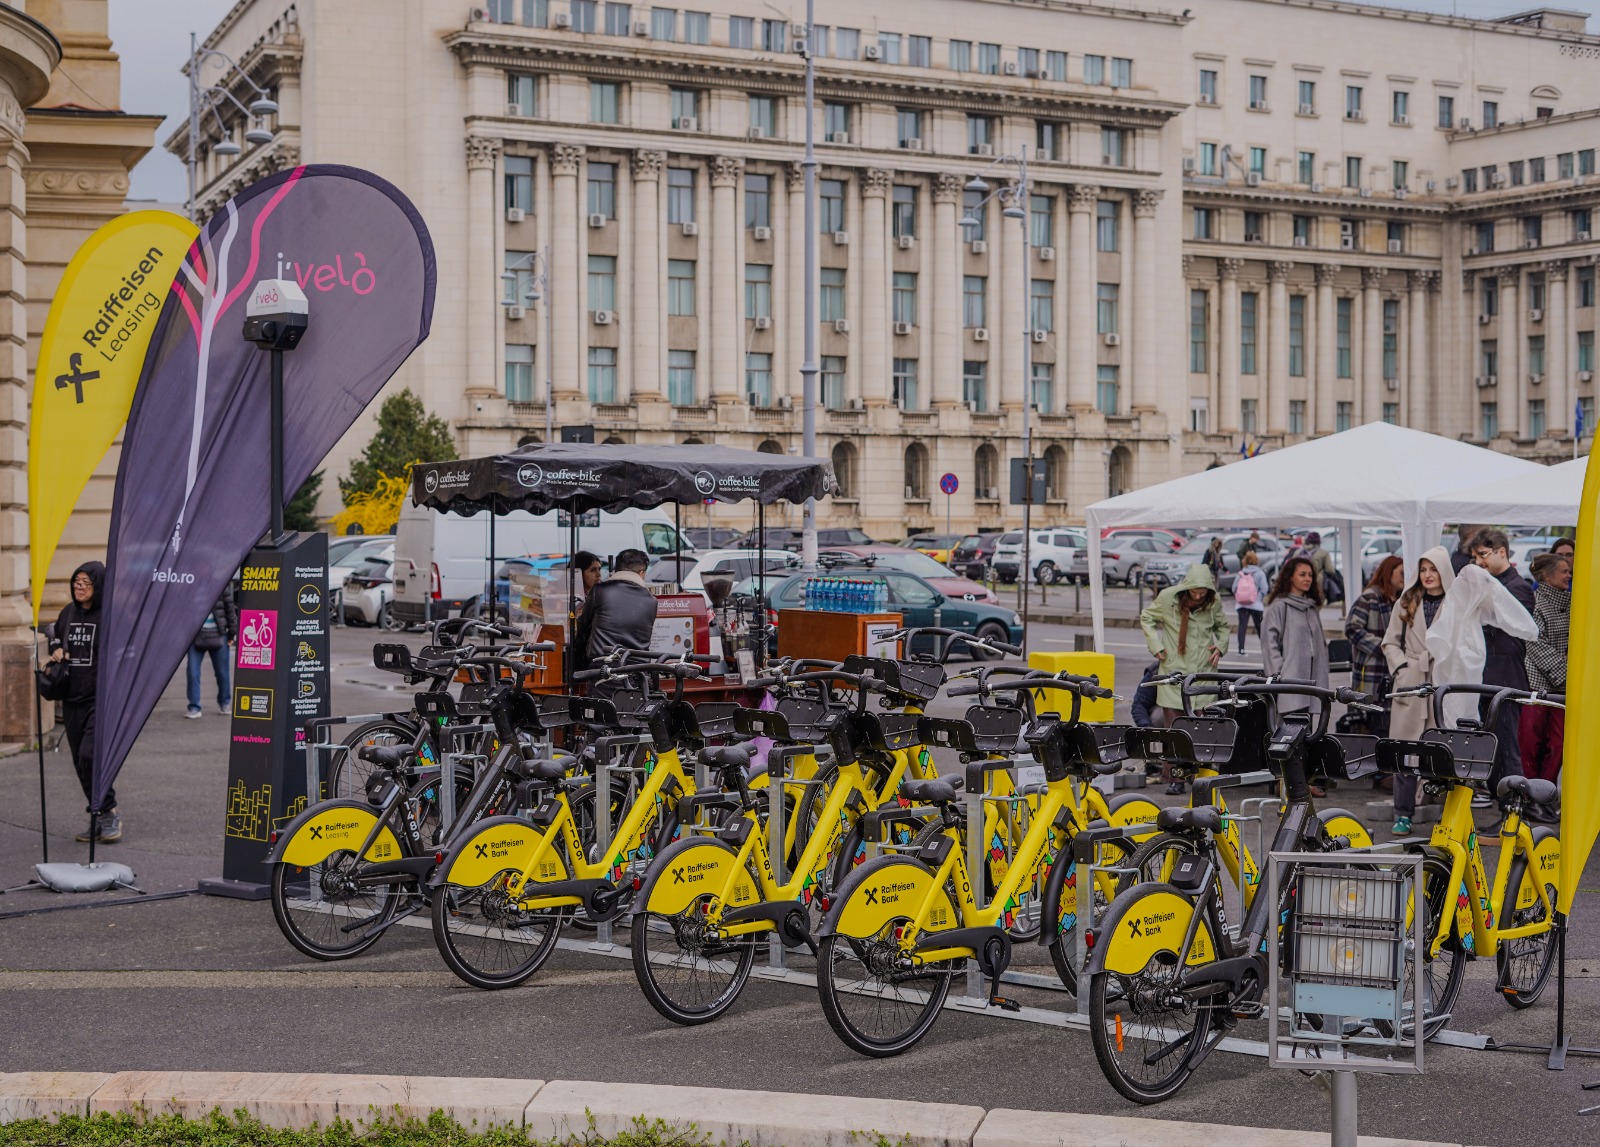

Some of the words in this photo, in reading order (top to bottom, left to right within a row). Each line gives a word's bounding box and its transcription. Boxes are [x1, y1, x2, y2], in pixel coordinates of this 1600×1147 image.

[82, 247, 164, 348] Raiffeisen
[100, 291, 161, 362] Leasing
[440, 470, 470, 483] coffee-bike
[546, 468, 601, 482] coffee-bike
[718, 475, 760, 487] coffee-bike
[242, 567, 280, 580] SMART
[241, 580, 279, 591] STATION
[300, 594, 320, 604] 24h
[325, 822, 359, 832] Raiffeisen
[403, 800, 420, 842] 1489
[325, 831, 349, 840] Leasing
[566, 817, 584, 861] 1109
[490, 839, 524, 850] Raiffeisen
[491, 849, 509, 858] Bank
[757, 836, 774, 882] 1184
[687, 861, 719, 873] Raiffeisen
[688, 871, 705, 883] Bank
[956, 857, 974, 905] 1104
[881, 882, 915, 894] Raiffeisen
[881, 895, 899, 904] Bank
[1212, 883, 1229, 936] 1488
[1143, 911, 1175, 926] Raiffeisen
[1145, 924, 1162, 936] Bank
